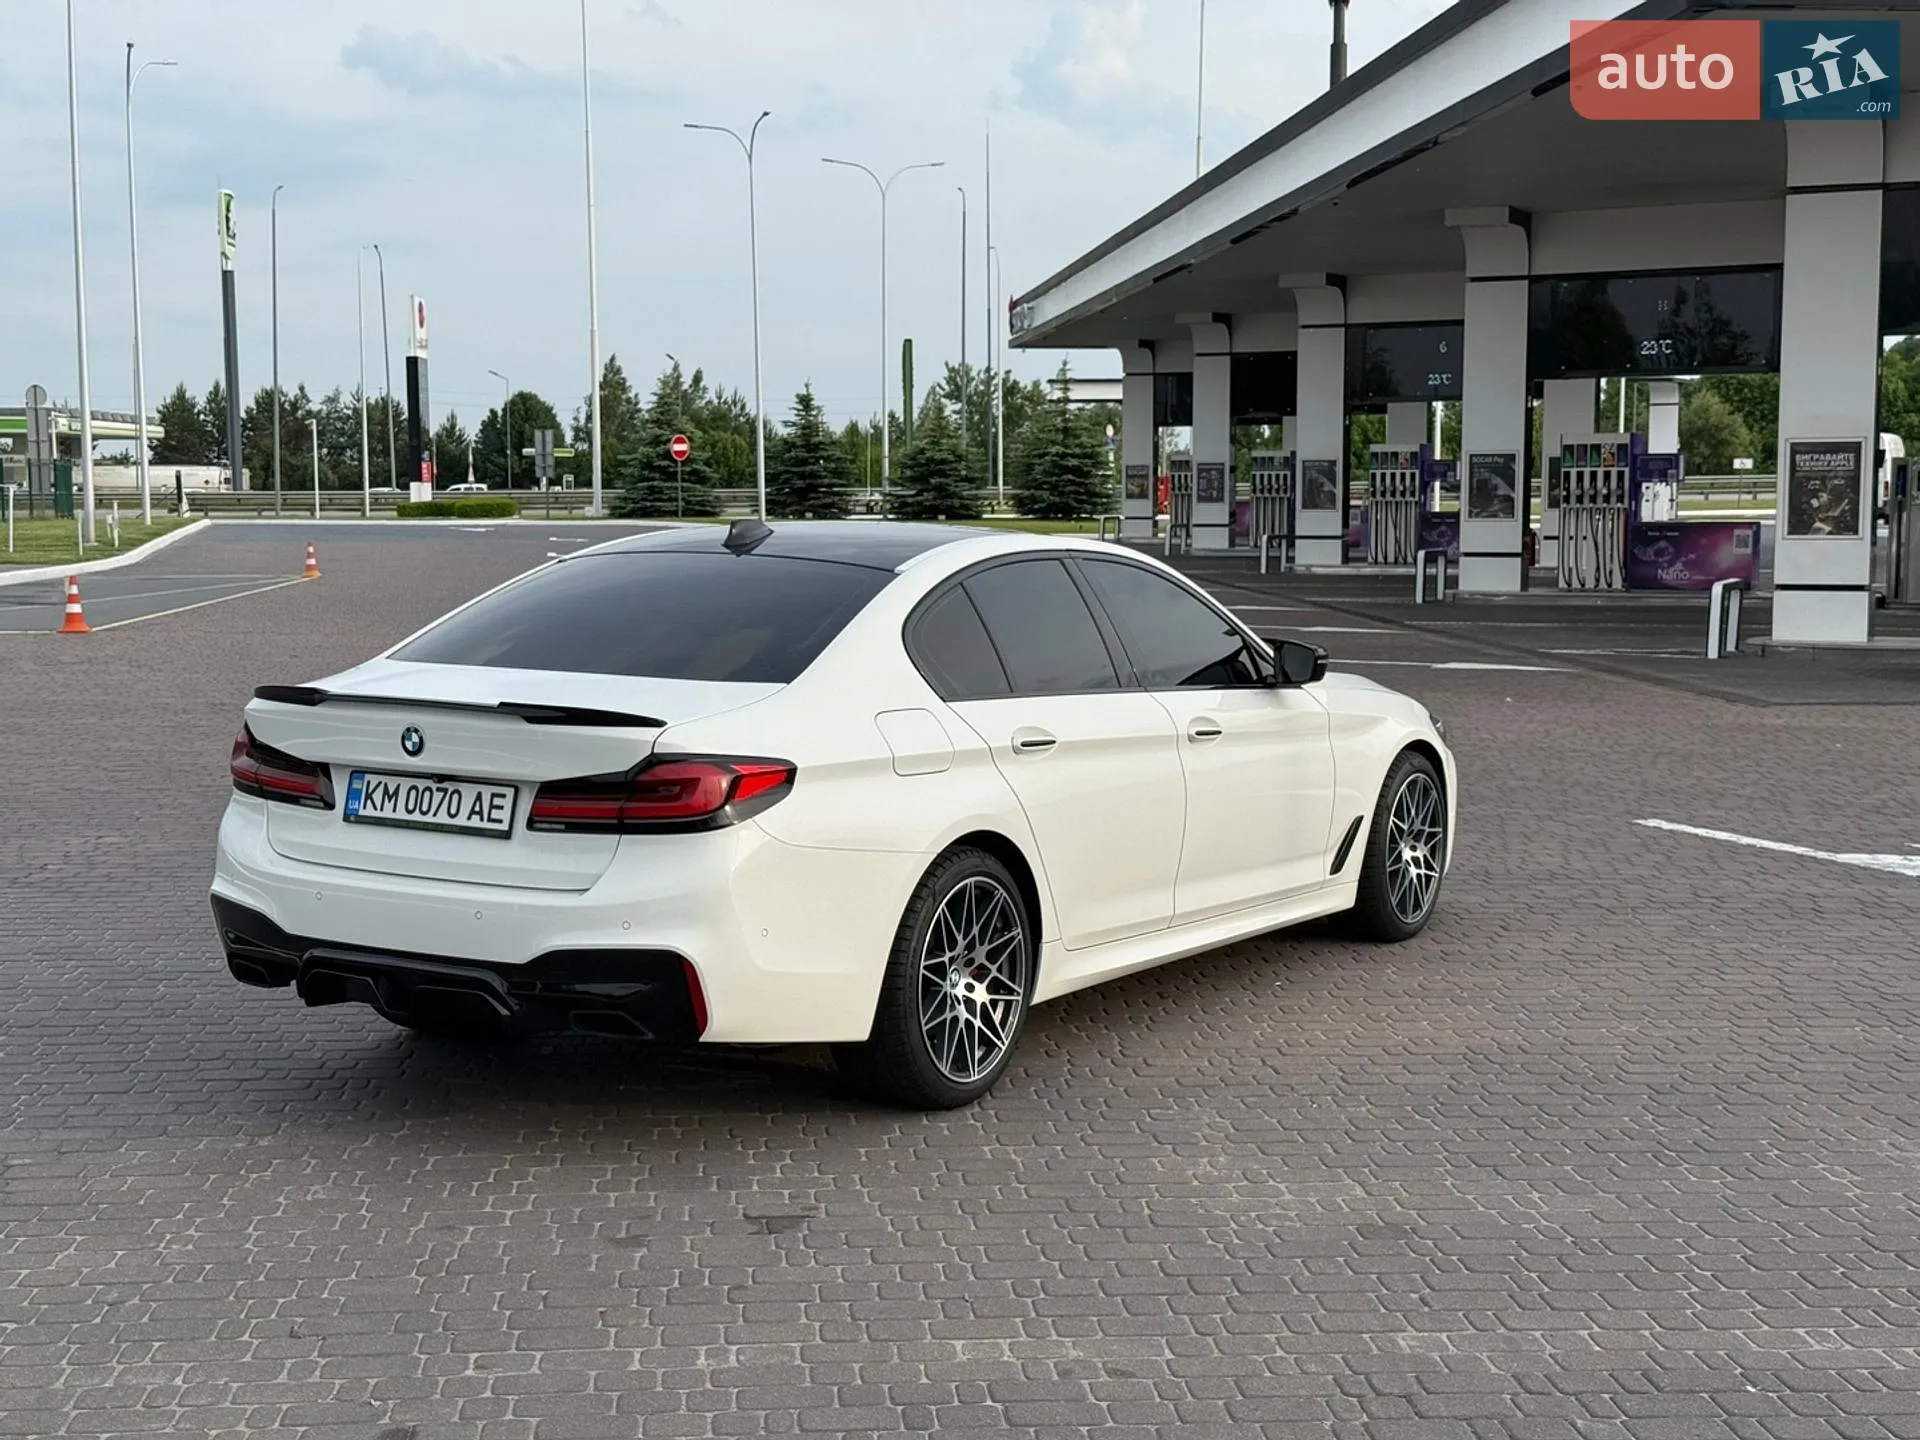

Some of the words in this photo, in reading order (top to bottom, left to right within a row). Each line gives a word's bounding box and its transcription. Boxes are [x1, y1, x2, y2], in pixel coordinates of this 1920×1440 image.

[362, 779, 401, 814] KM
[404, 784, 463, 819] 0070
[467, 791, 507, 825] AE
